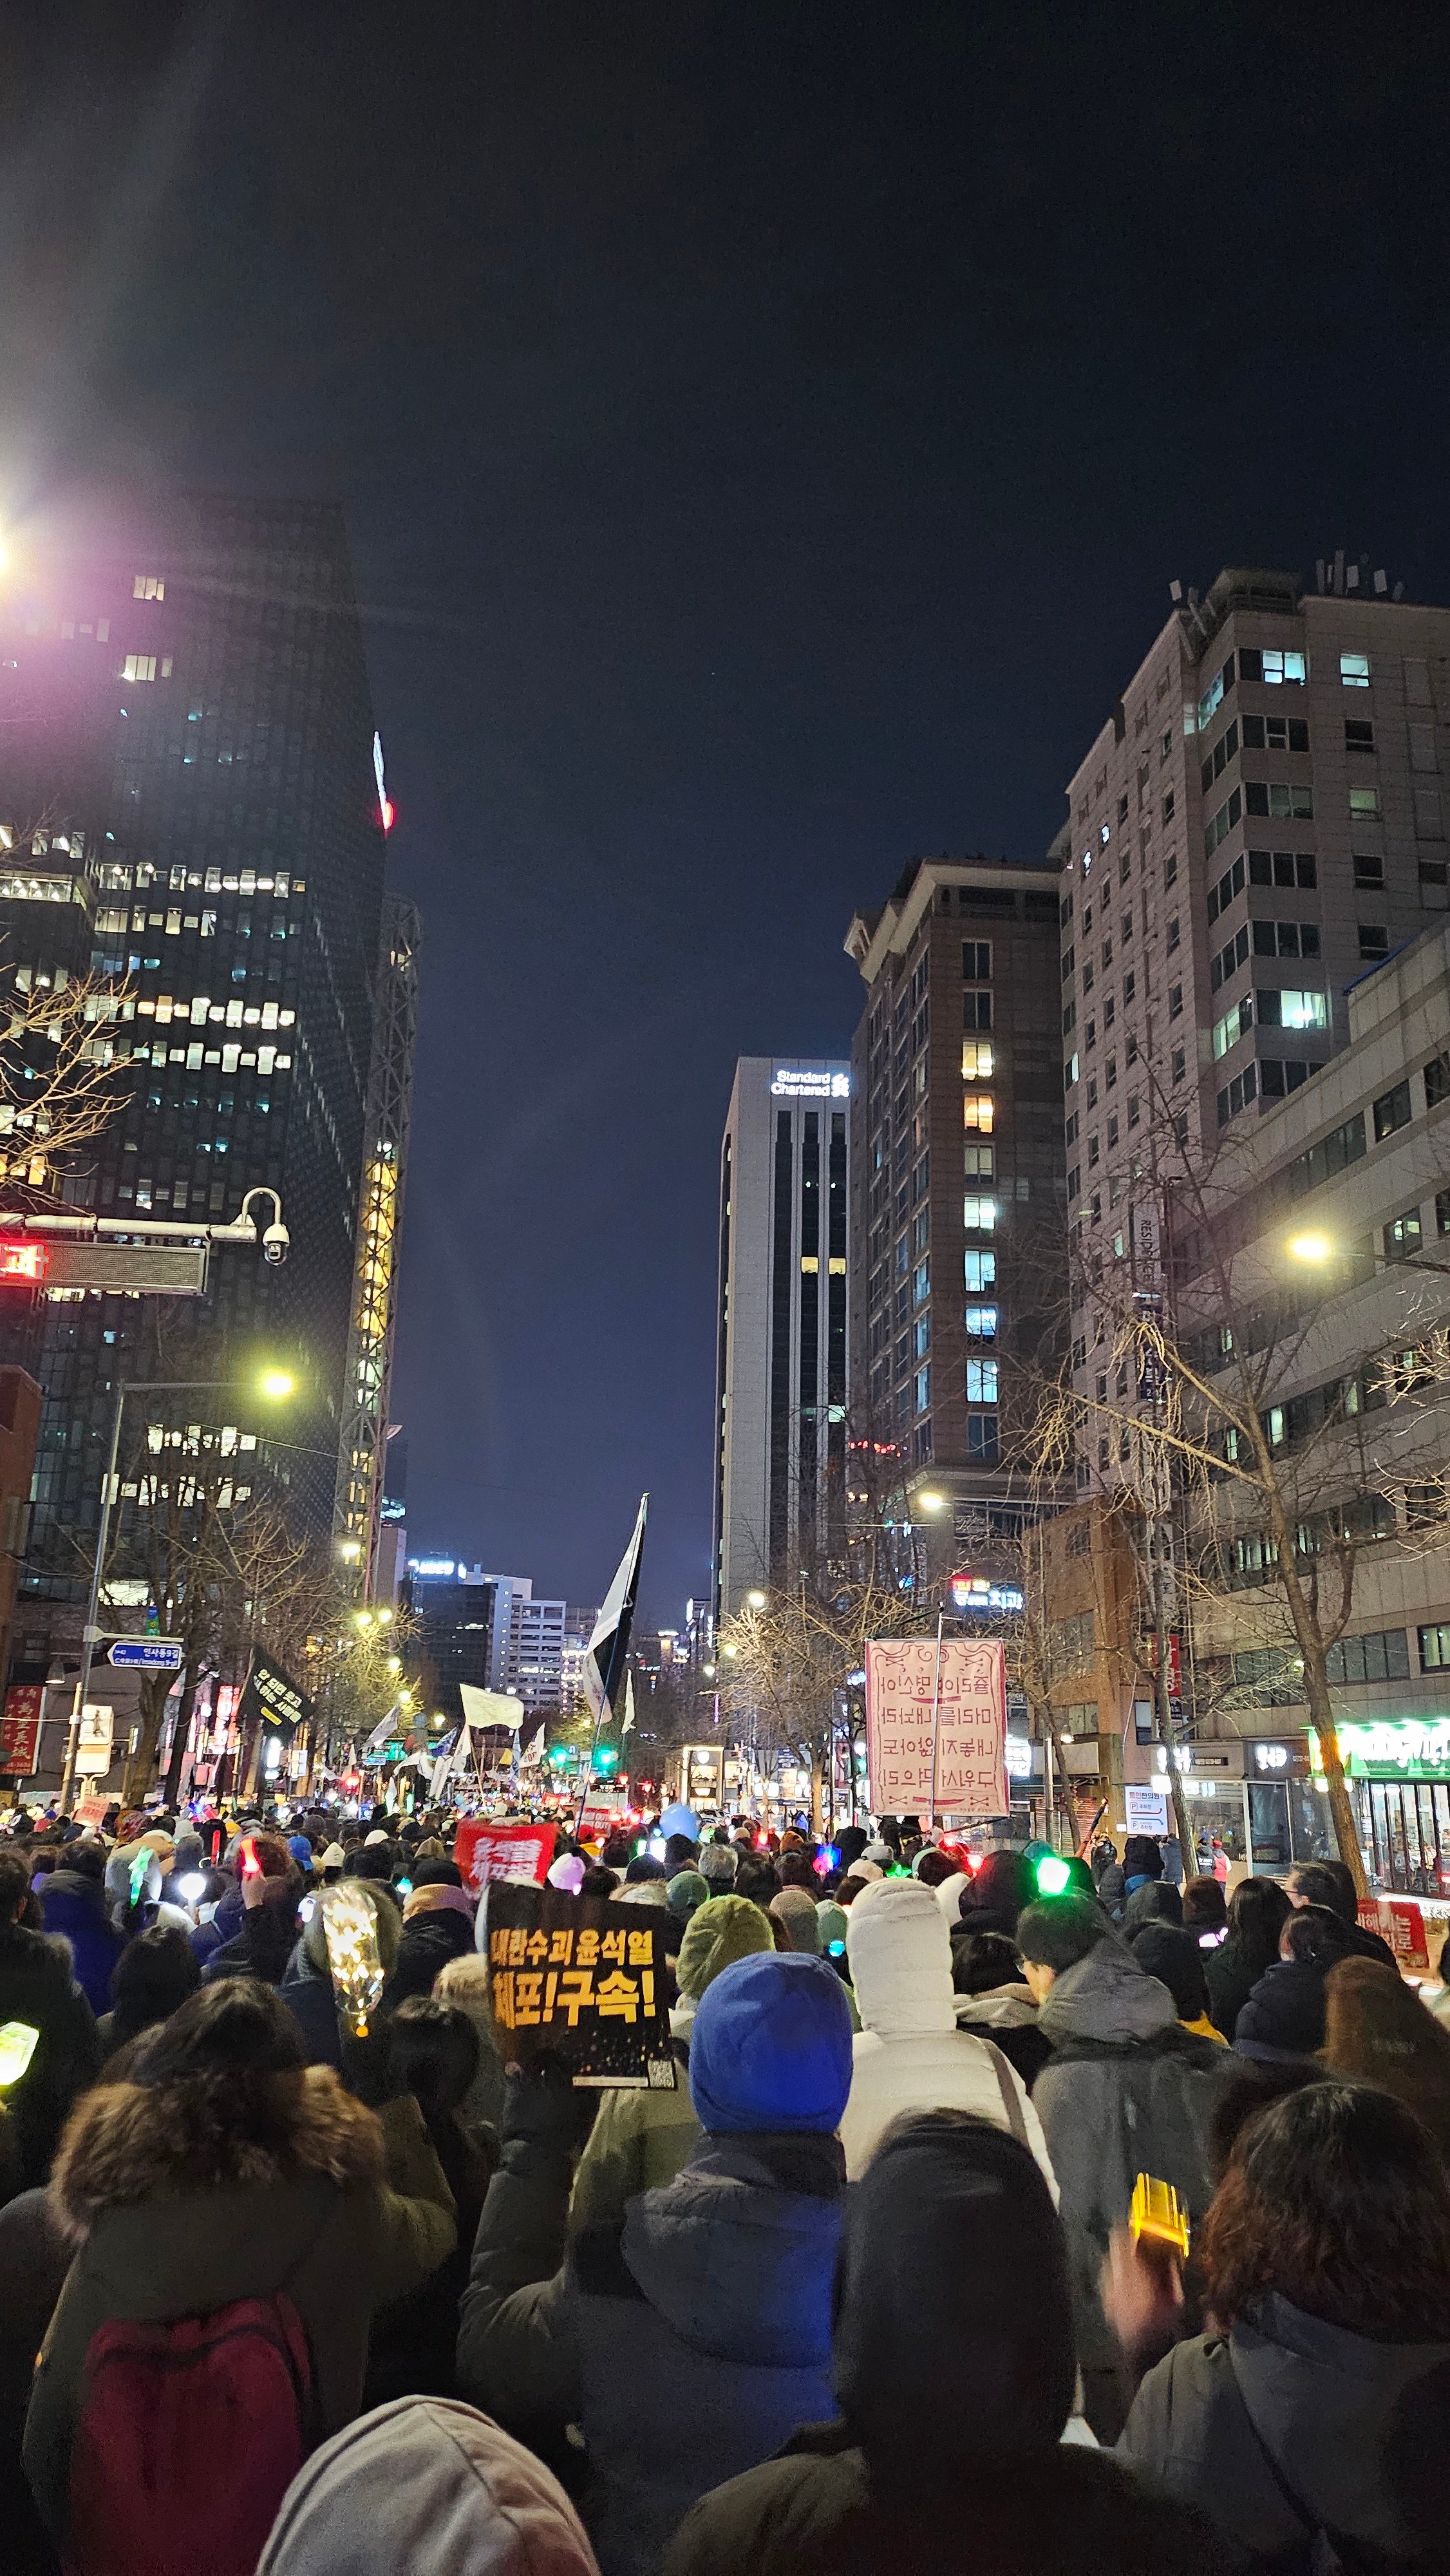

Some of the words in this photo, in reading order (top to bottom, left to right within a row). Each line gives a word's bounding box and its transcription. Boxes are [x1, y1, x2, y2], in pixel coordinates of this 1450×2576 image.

[777, 1070, 831, 1084] Standard
[771, 1083, 831, 1096] Chartered
[143, 1647, 180, 1659] 인사동9길
[490, 1929, 574, 1966] 내란수괴
[576, 1929, 654, 1966] 윤석열
[493, 1971, 558, 2030] 체포!
[557, 1970, 655, 2027] 구속!
